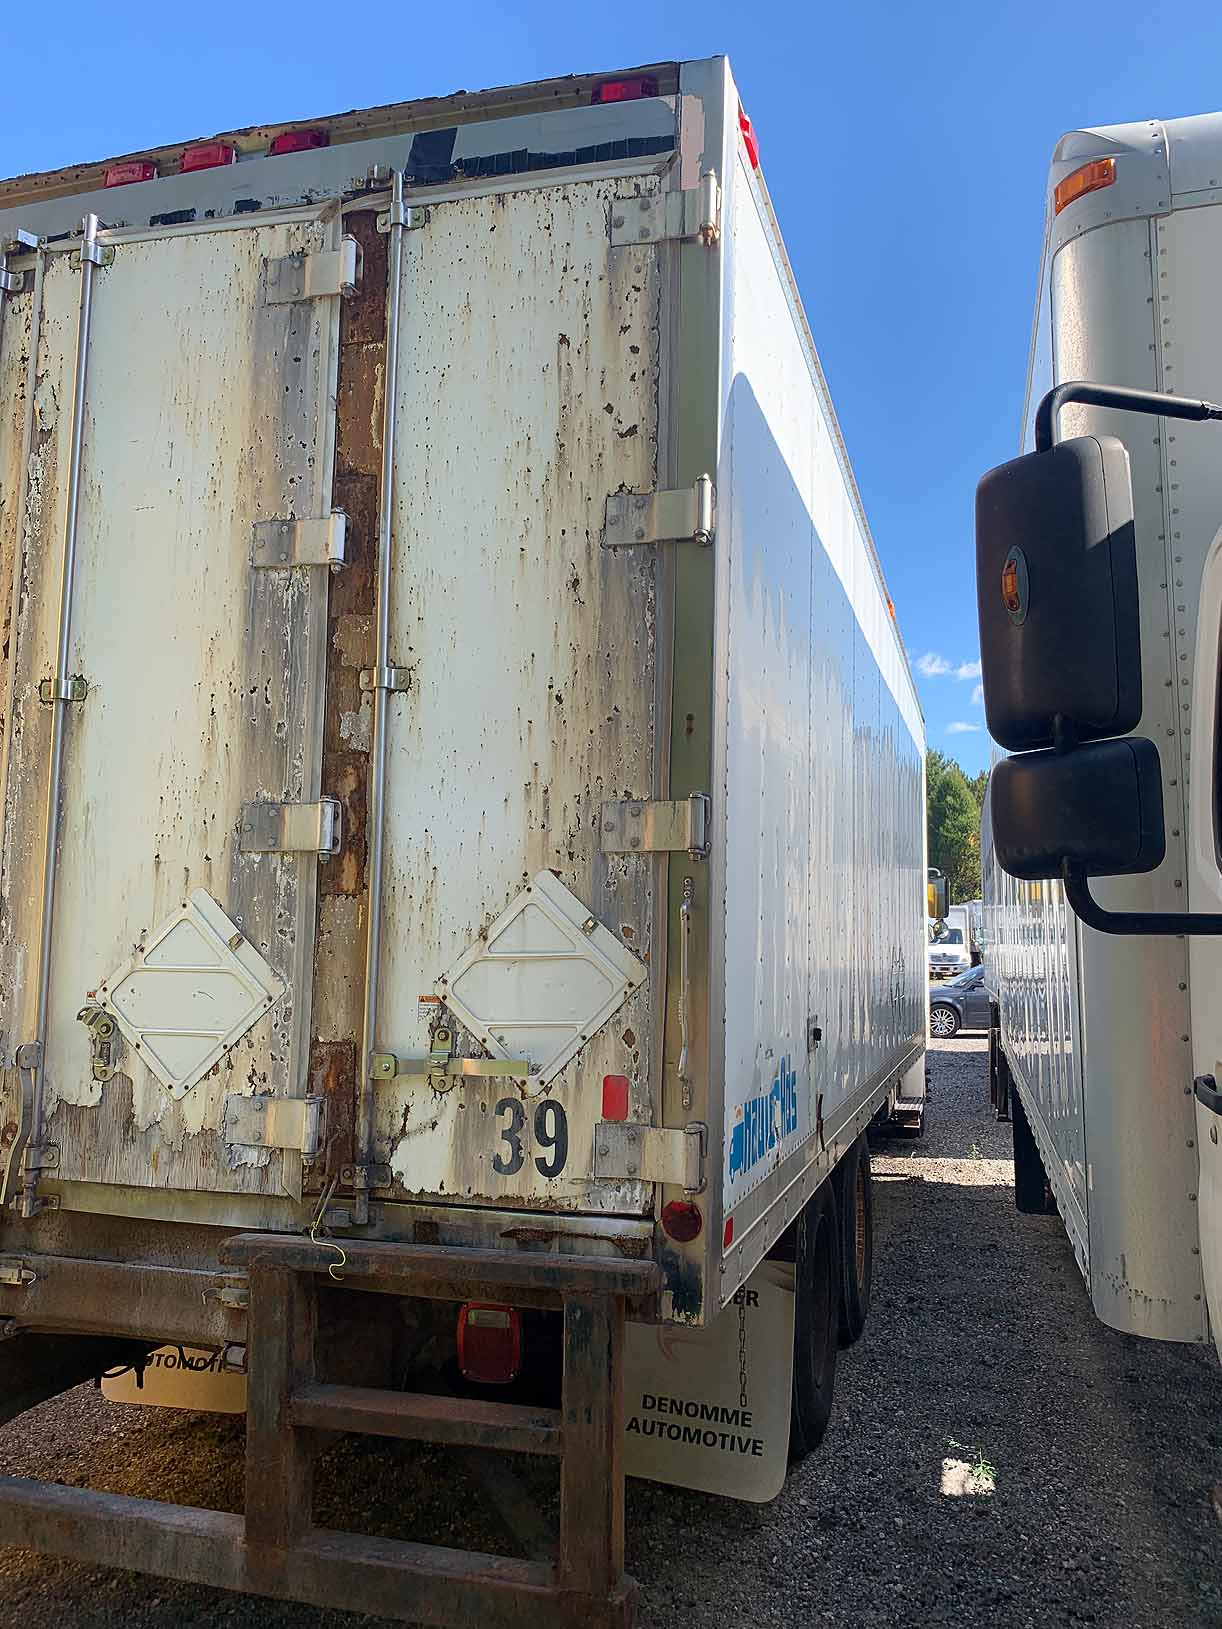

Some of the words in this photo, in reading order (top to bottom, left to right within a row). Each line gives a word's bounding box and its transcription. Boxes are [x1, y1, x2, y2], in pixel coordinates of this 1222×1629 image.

[492, 1097, 568, 1178] 39
[641, 1393, 753, 1428] DENOMME
[625, 1416, 764, 1457] AUTOMOTIVE
